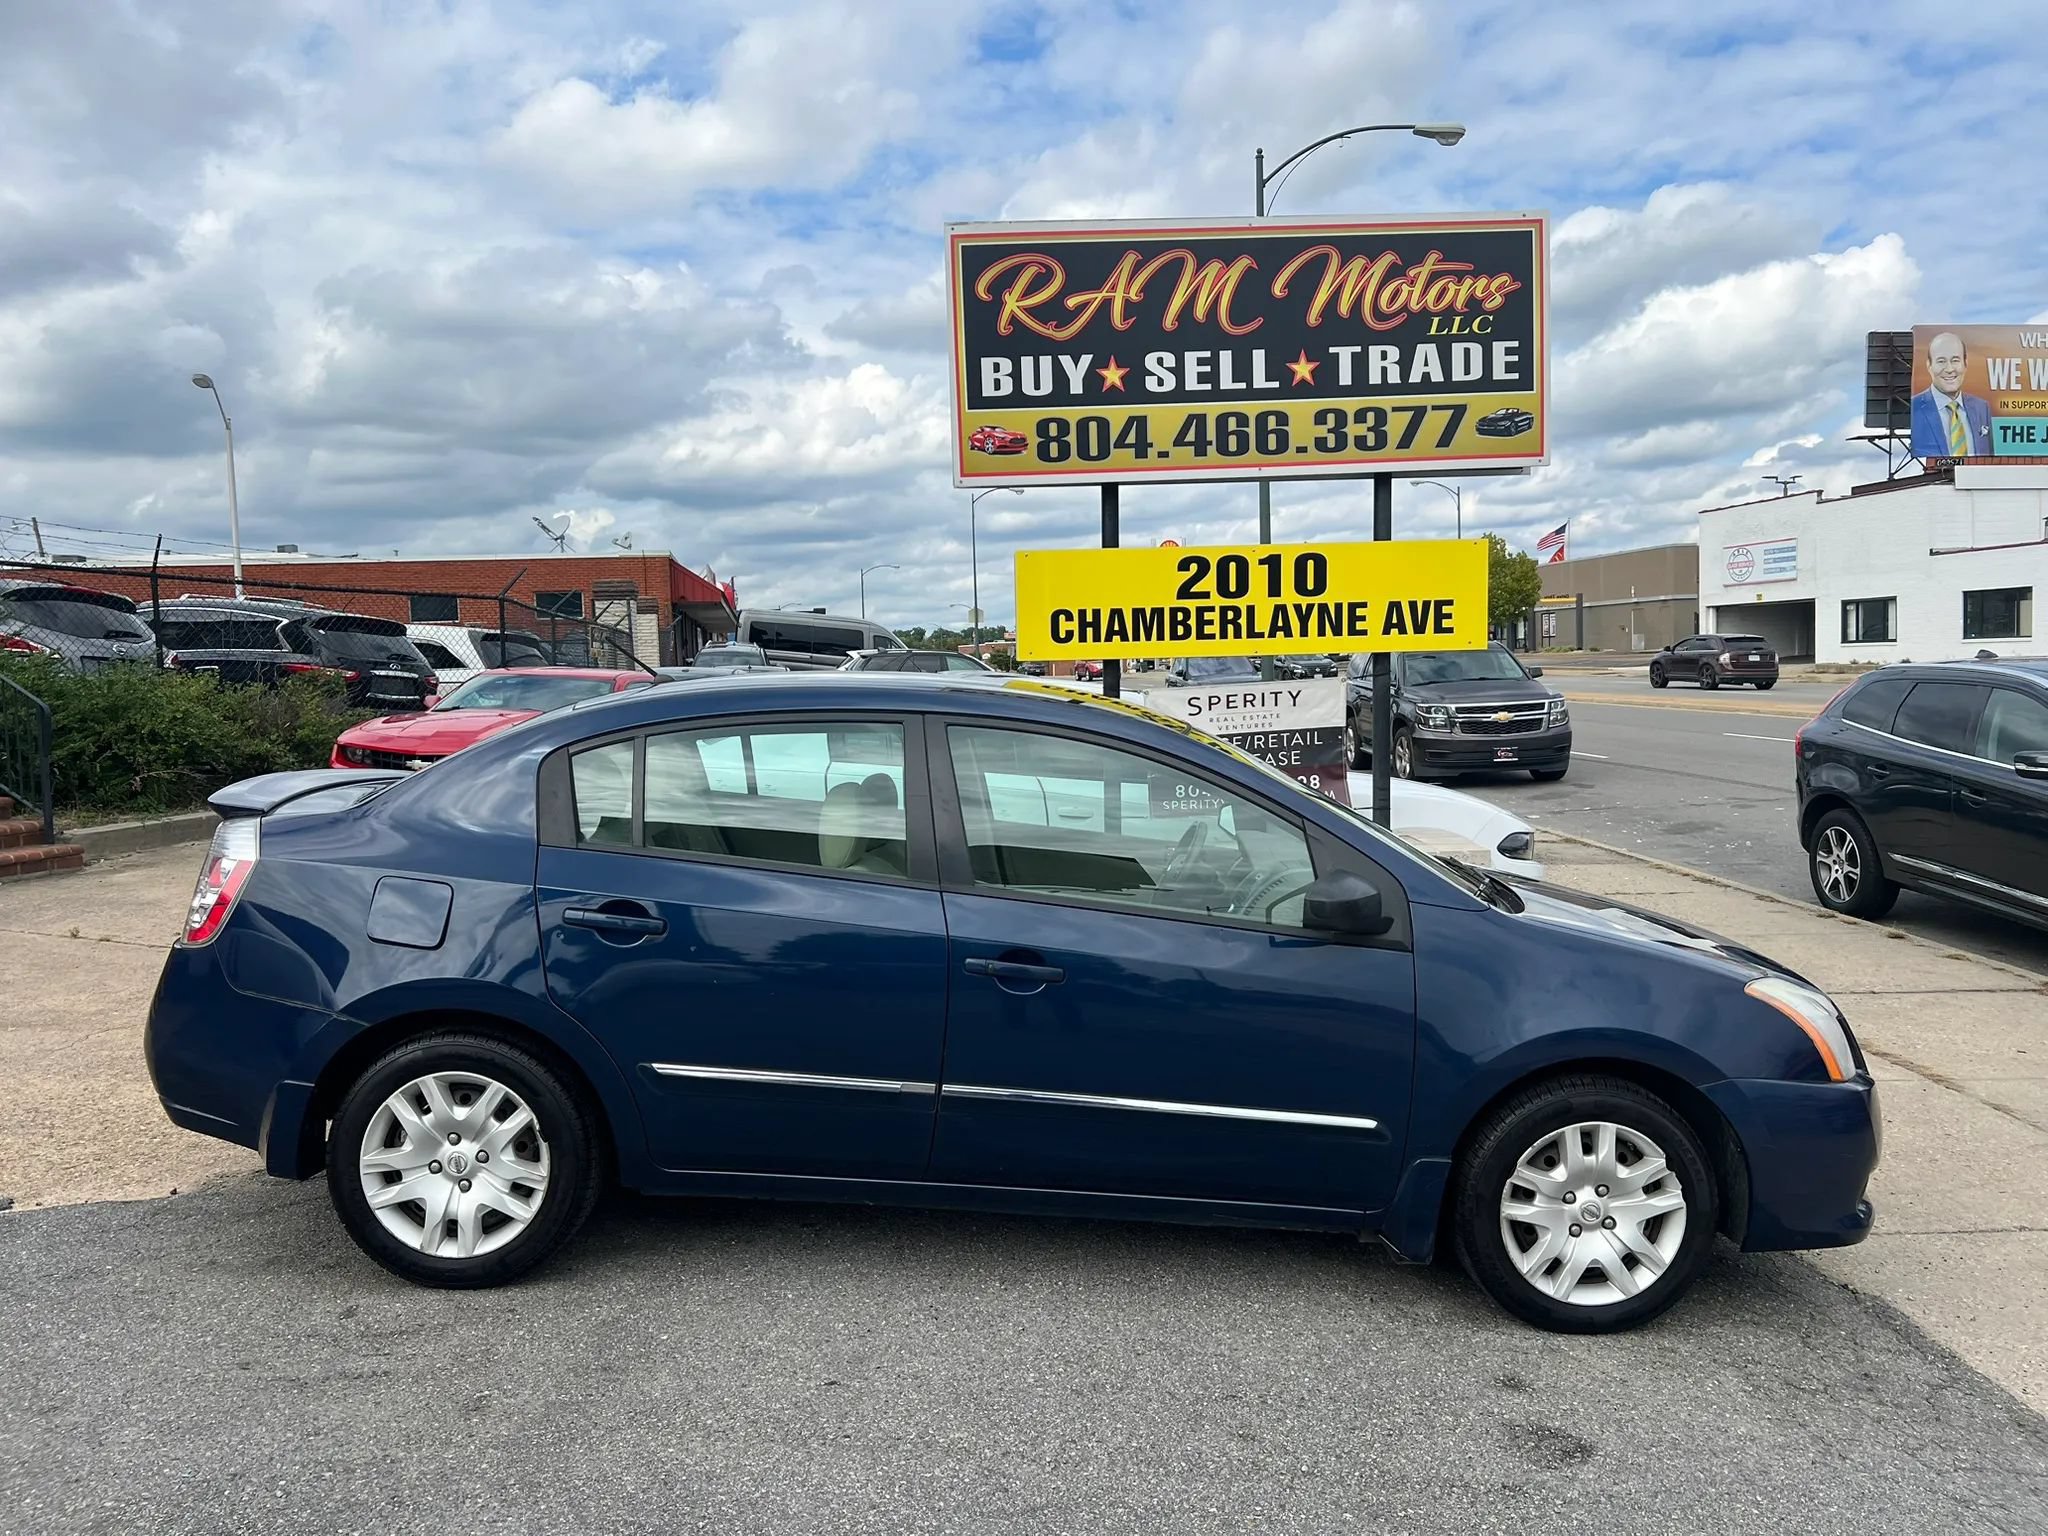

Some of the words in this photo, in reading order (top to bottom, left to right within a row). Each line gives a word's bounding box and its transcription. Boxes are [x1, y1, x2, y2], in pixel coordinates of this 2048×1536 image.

[974, 247, 1264, 341] RAM
[1272, 244, 1522, 332] Motors
[1427, 314, 1494, 336] LLC
[980, 353, 1098, 398] BUY
[1145, 348, 1280, 392] SELL
[1329, 341, 1520, 387] TRADE
[1987, 357, 2021, 391] WE
[2000, 400, 2009, 409] IN
[2011, 400, 2048, 409] SUPPOR
[1036, 404, 1469, 464] 804.466.3377
[2000, 425, 2036, 443] THE
[1175, 552, 1328, 601] 2010
[1050, 602, 1368, 645] CHAMBERLAYNE
[1381, 598, 1455, 636] AVE
[1187, 689, 1302, 716] SPERITY
[1209, 716, 1235, 724] REAL
[1242, 713, 1281, 721] ESTATE
[1218, 722, 1273, 731] VENTURES
[1224, 731, 1323, 749] E/RETAIL
[1256, 751, 1301, 766] ASE
[1175, 785, 1211, 798] 80
[1163, 798, 1225, 810] SPERITY
